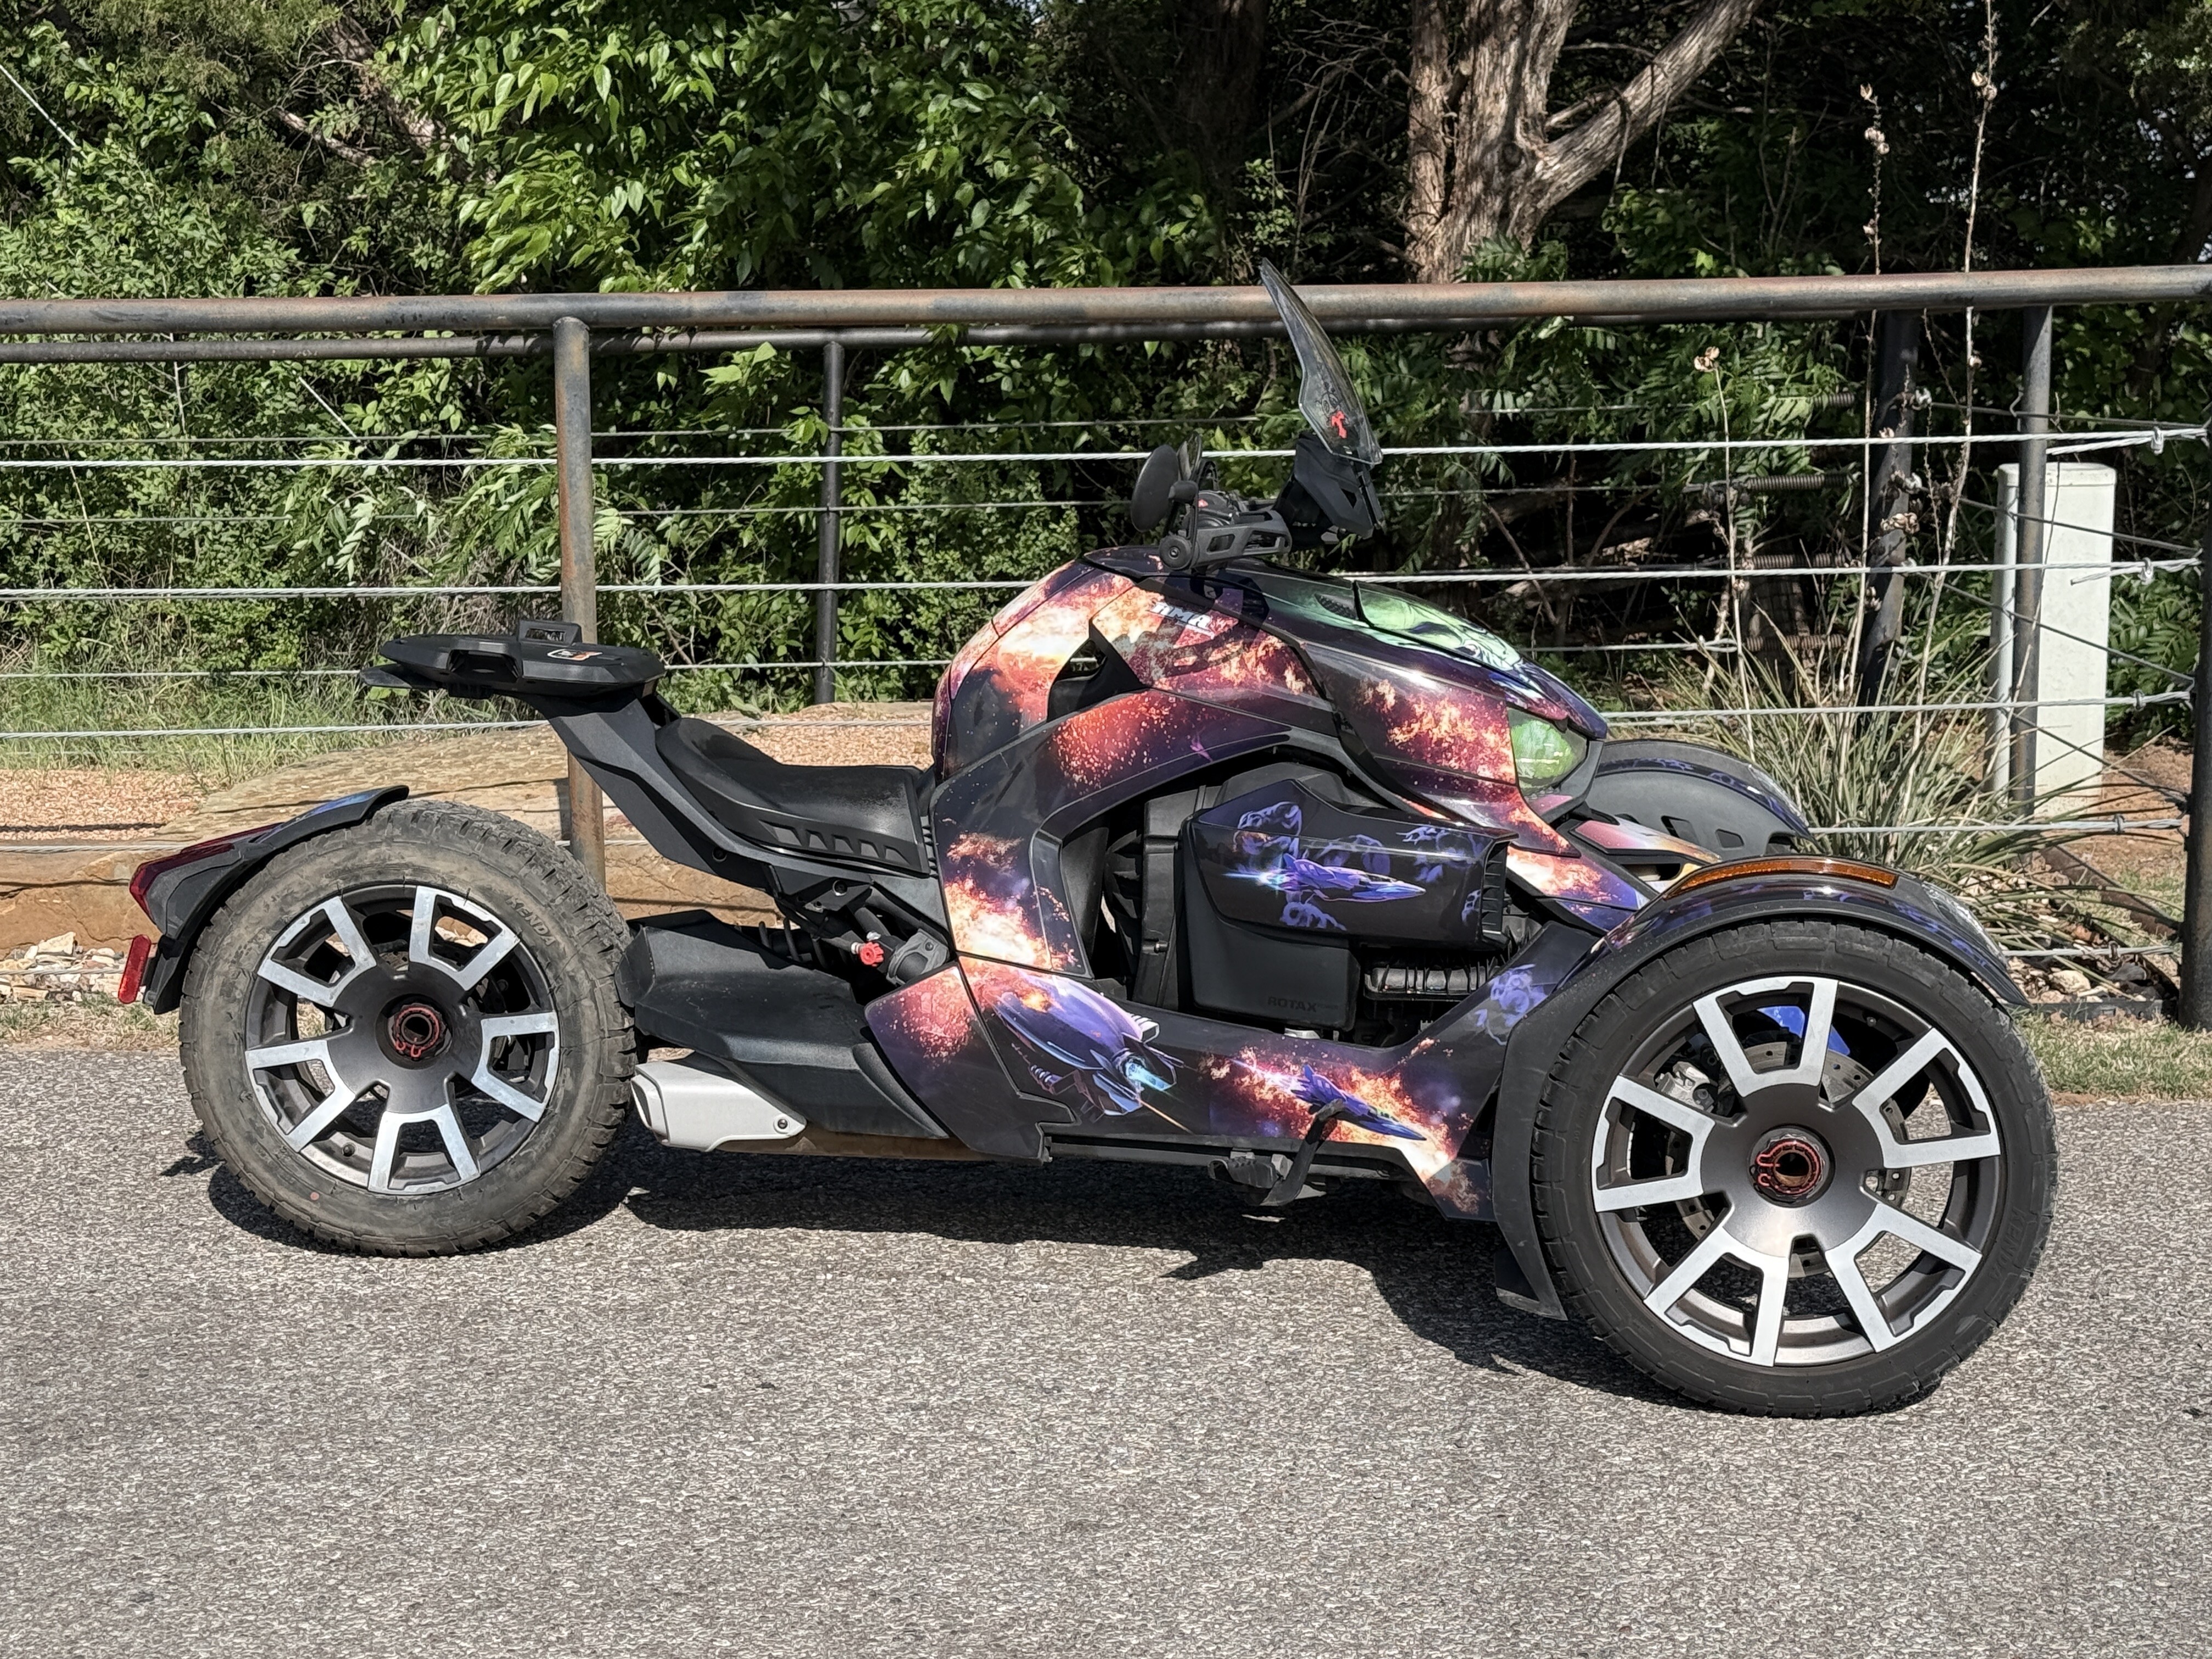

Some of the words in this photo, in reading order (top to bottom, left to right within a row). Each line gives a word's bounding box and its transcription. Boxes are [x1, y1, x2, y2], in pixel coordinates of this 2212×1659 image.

[504, 895, 557, 946] KENDA
[1267, 996, 1317, 1013] ROTAX
[1988, 1205, 2028, 1280] KENDA
